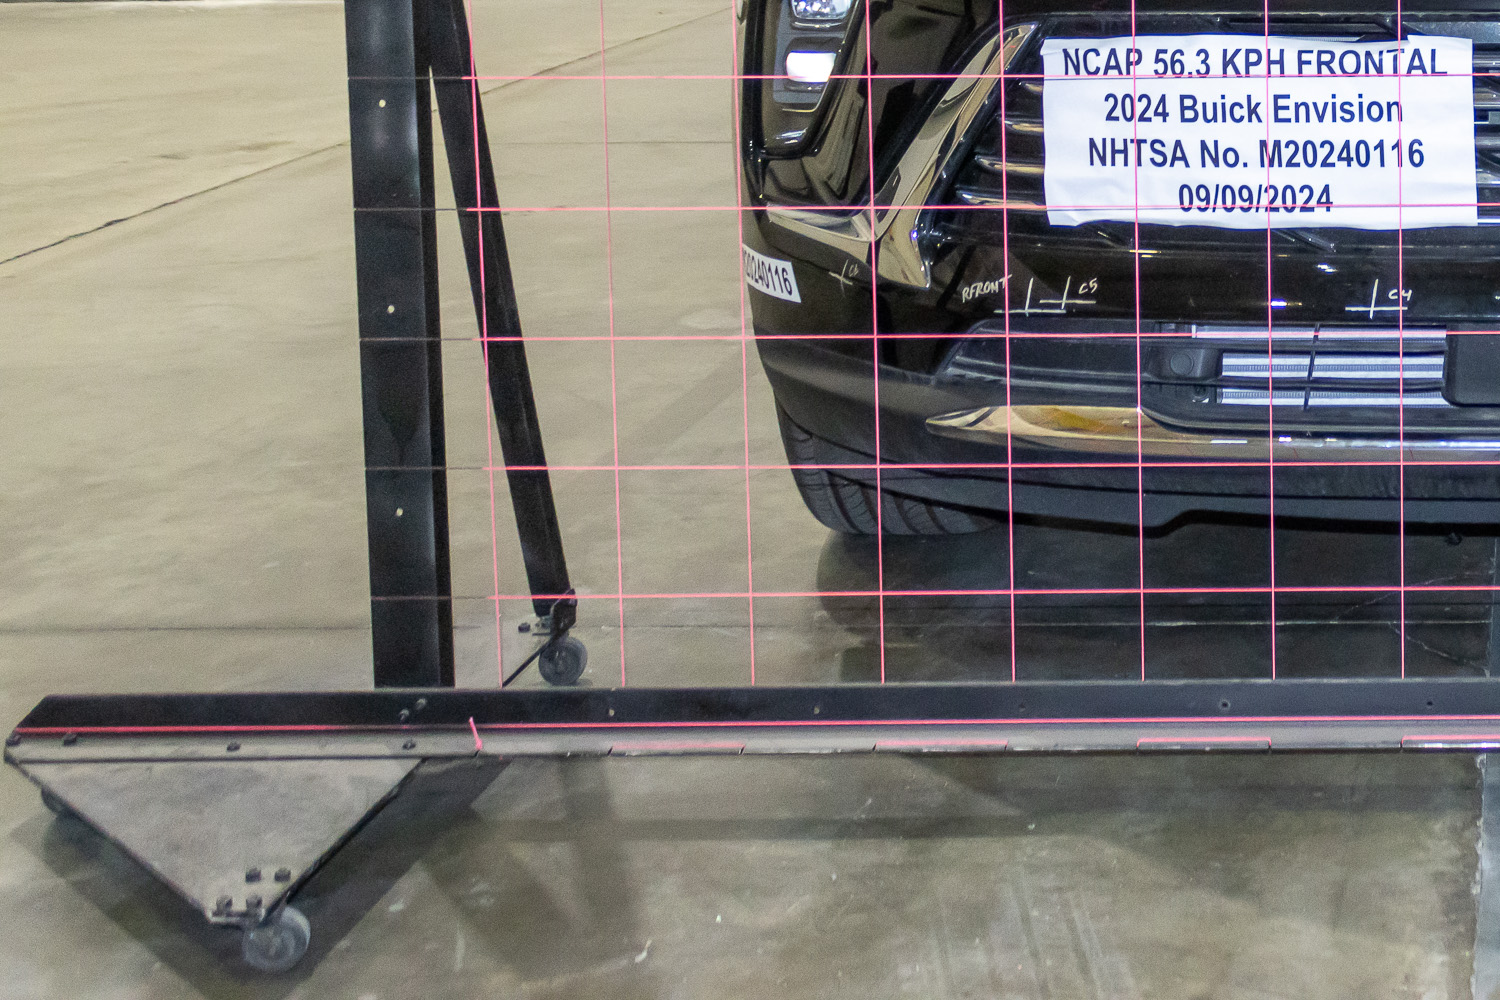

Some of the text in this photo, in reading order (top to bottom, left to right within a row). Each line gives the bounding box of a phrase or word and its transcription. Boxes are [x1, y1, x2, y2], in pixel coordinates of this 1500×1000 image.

[1062, 48, 1448, 78] NCAP 56.3 KPH FRONTAL
[1104, 93, 1403, 123] 2024 Buick Envision
[1089, 138, 1424, 168] NHTSA No. M20240116
[1179, 184, 1333, 213] 09/09/2024
[1388, 289, 1412, 301] C4
